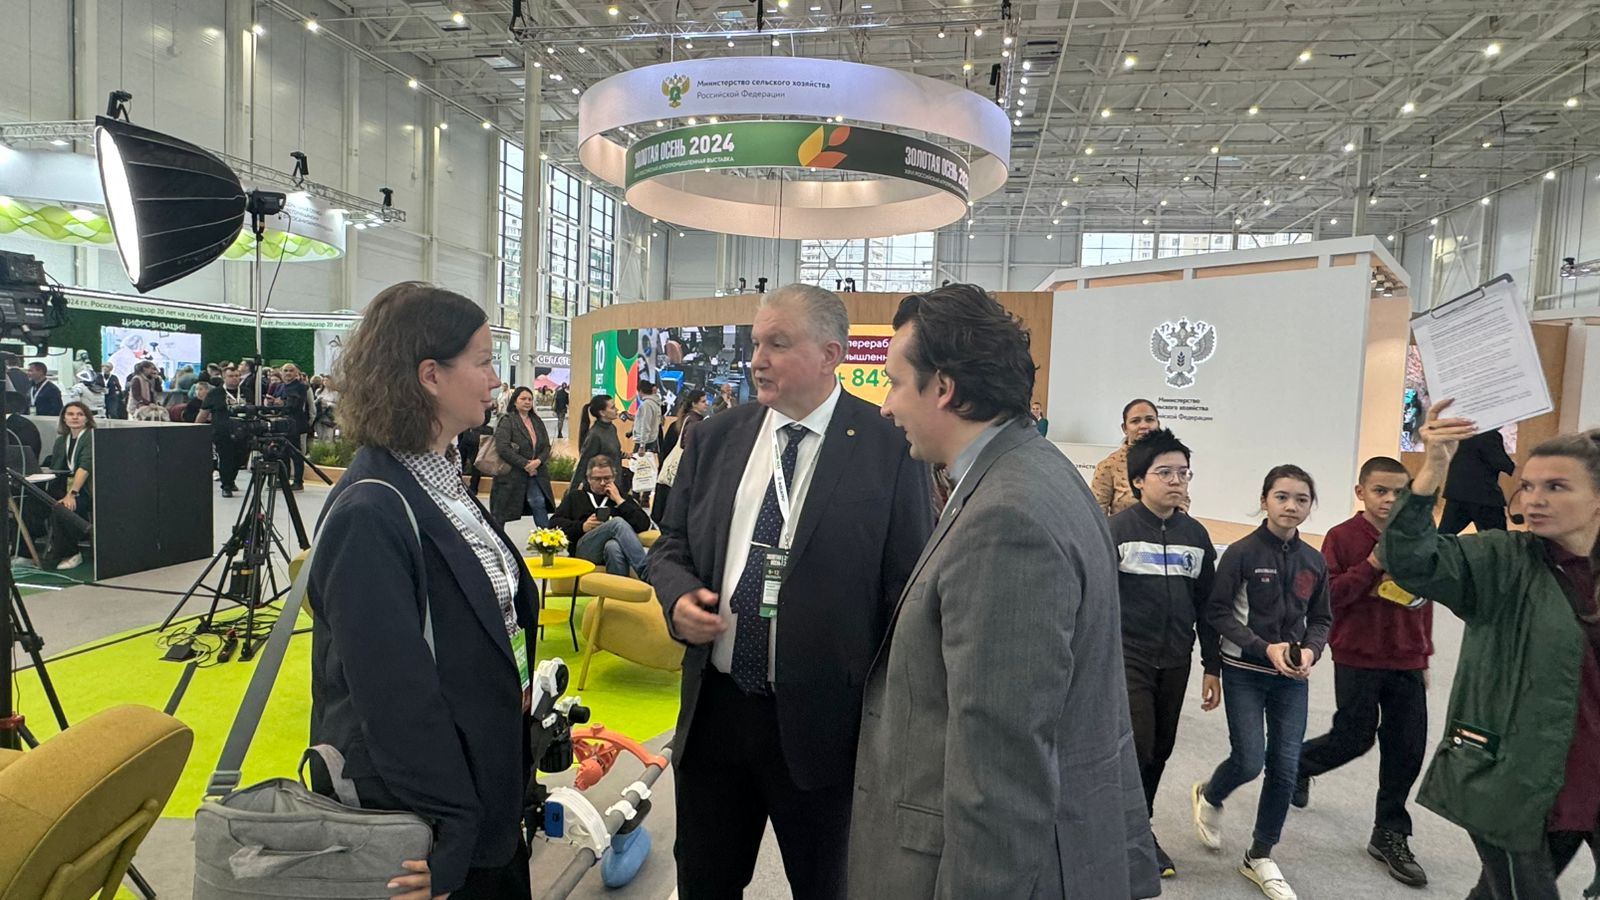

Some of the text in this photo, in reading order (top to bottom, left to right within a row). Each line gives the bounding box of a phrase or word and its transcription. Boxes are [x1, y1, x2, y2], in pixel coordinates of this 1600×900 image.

[697, 79, 831, 89] Министерство сельского хозяйства
[697, 89, 785, 99] Российской Федерации
[660, 138, 686, 161] ОСЕНЬ
[689, 132, 735, 156] 2024
[904, 146, 941, 175] ЗОЛОТАЯ
[91, 301, 155, 314] Россельхознадзор
[187, 312, 209, 320] службе
[210, 313, 221, 321] АПК
[121, 318, 187, 331] ЦИФРОВИЗАЦИЯ
[595, 339, 605, 371] 10
